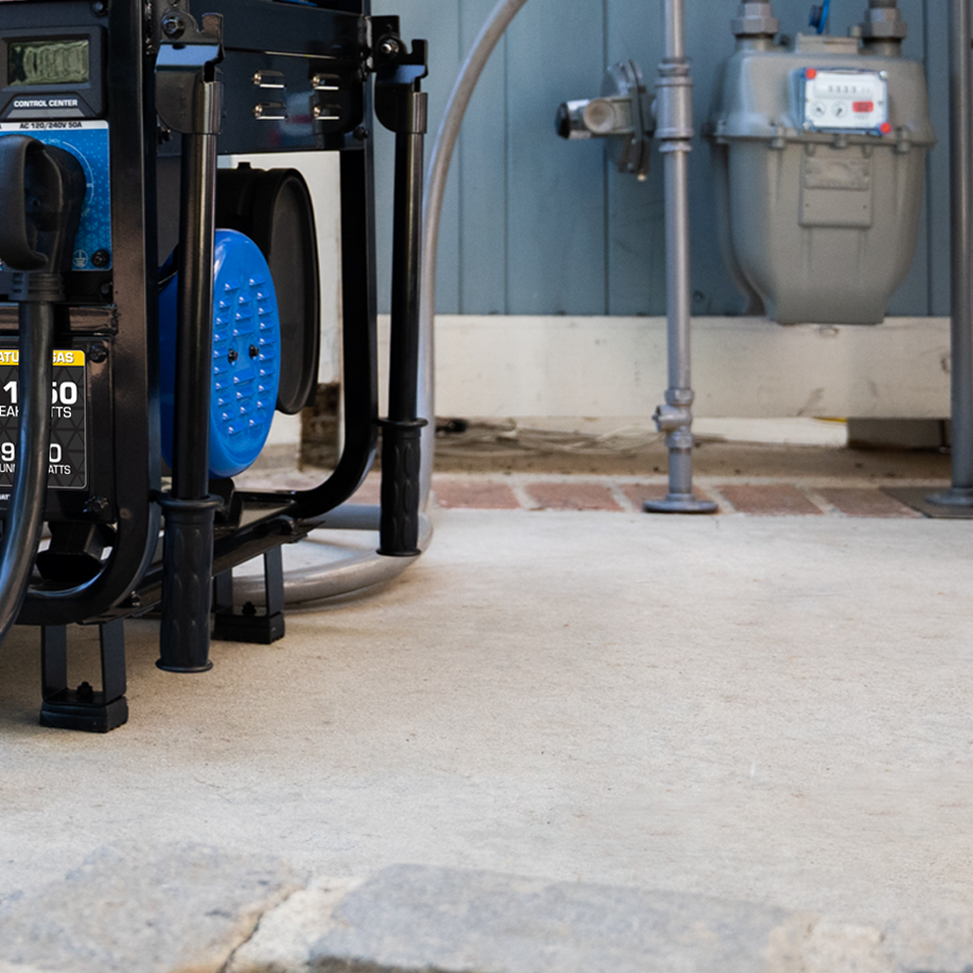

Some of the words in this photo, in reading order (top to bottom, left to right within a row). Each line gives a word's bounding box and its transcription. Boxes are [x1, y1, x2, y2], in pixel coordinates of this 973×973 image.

[13, 100, 48, 108] CONTROL
[48, 99, 78, 107] CENTER
[31, 122, 67, 130] 120/240V
